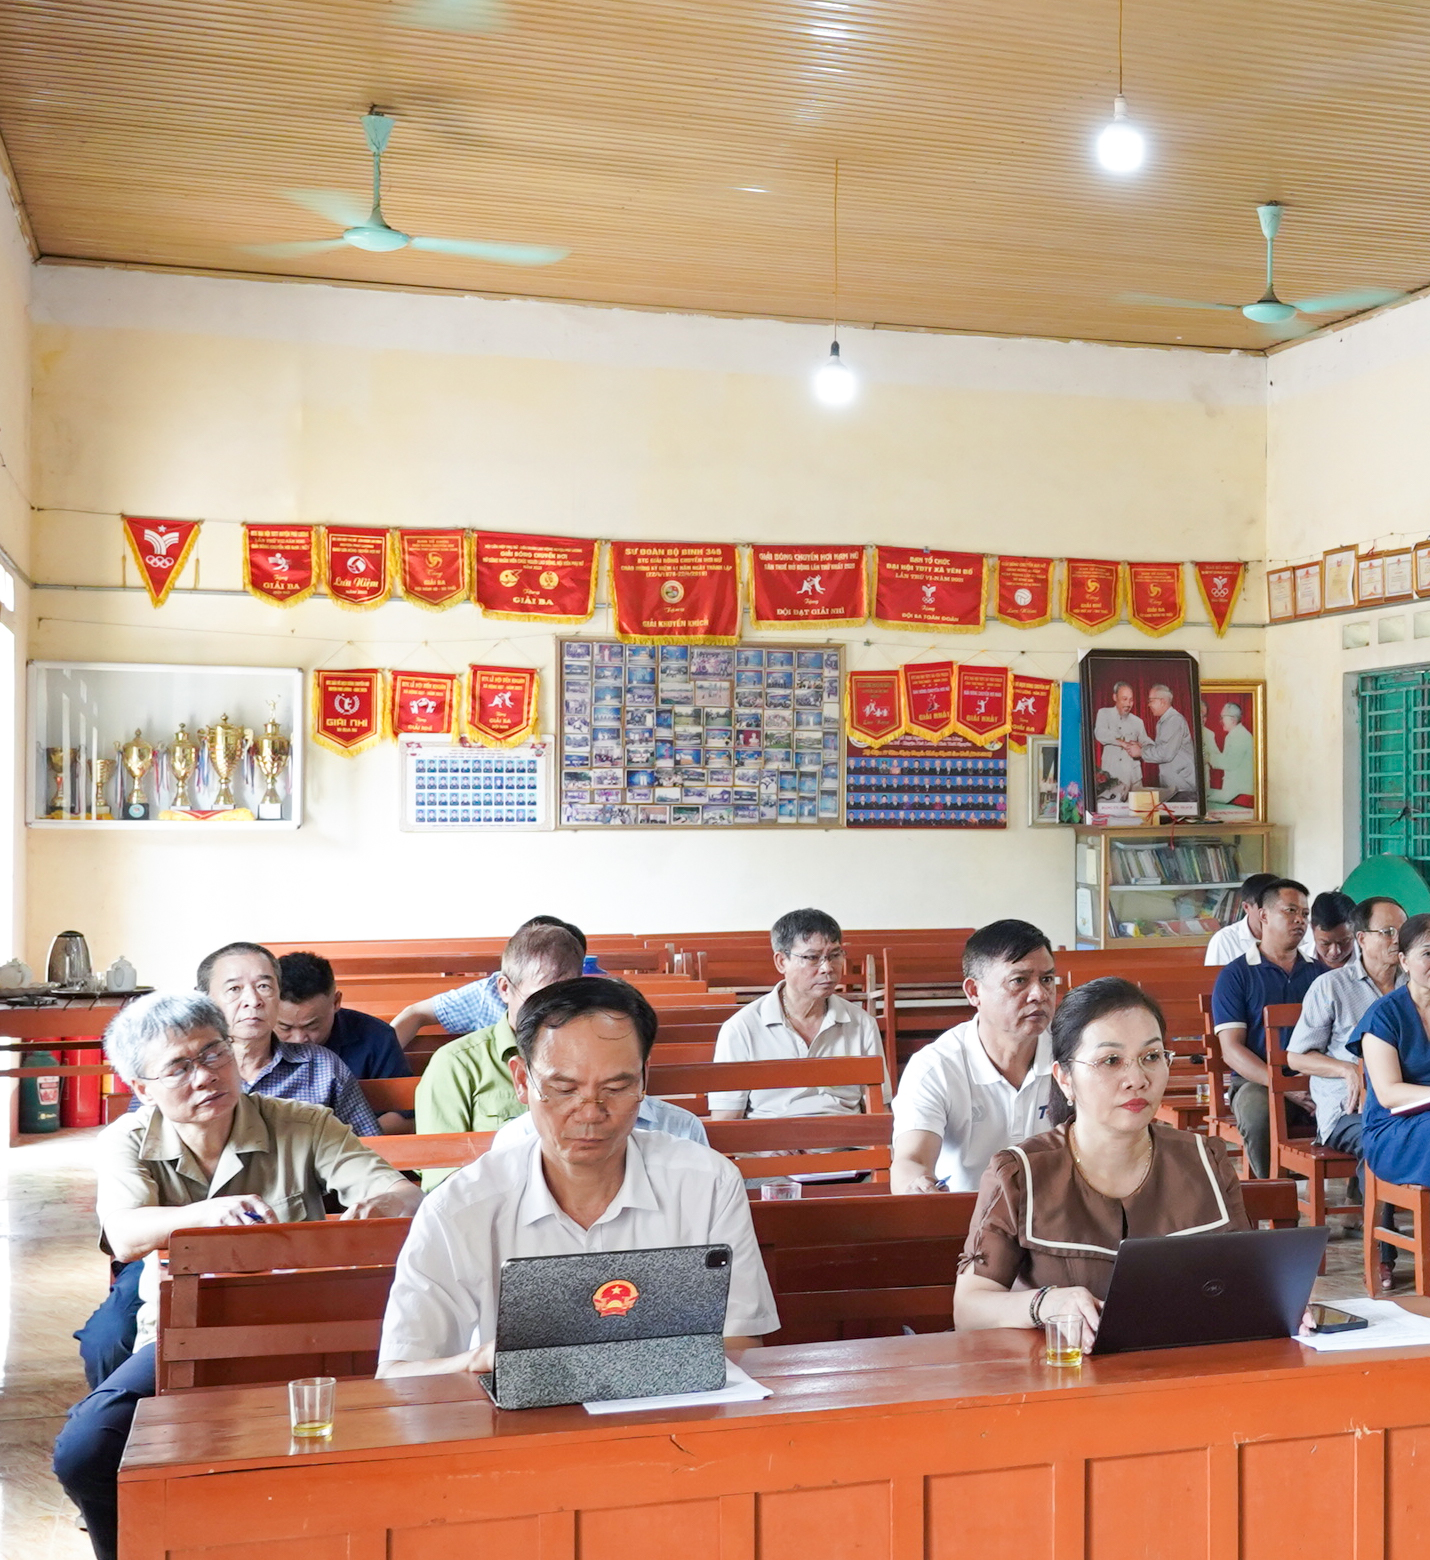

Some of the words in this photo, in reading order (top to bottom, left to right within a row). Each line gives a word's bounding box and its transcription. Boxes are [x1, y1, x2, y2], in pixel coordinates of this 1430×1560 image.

[625, 547, 639, 556] SƯ
[639, 547, 665, 556] ĐOÀN
[666, 547, 681, 557] BỘ
[681, 548, 703, 556] BINH
[758, 551, 773, 561] GIẢI
[773, 552, 793, 561] BÓNG
[794, 551, 819, 561] CHUYỀN
[901, 563, 914, 572] HỘI
[946, 566, 962, 574] YÊN
[263, 581, 285, 590] GIẢI
[287, 582, 301, 590] BA
[512, 596, 536, 605] GIẢI
[538, 598, 554, 606] BA
[777, 607, 791, 616] ĐỘI
[793, 609, 810, 617] ĐẠT
[811, 606, 829, 615] GIẢI
[642, 618, 657, 628] GIẢI
[658, 618, 686, 628] KHUYẾN
[687, 616, 709, 627] KHÍCH
[326, 717, 347, 727] GIẢI
[349, 718, 368, 727] NHÌ
